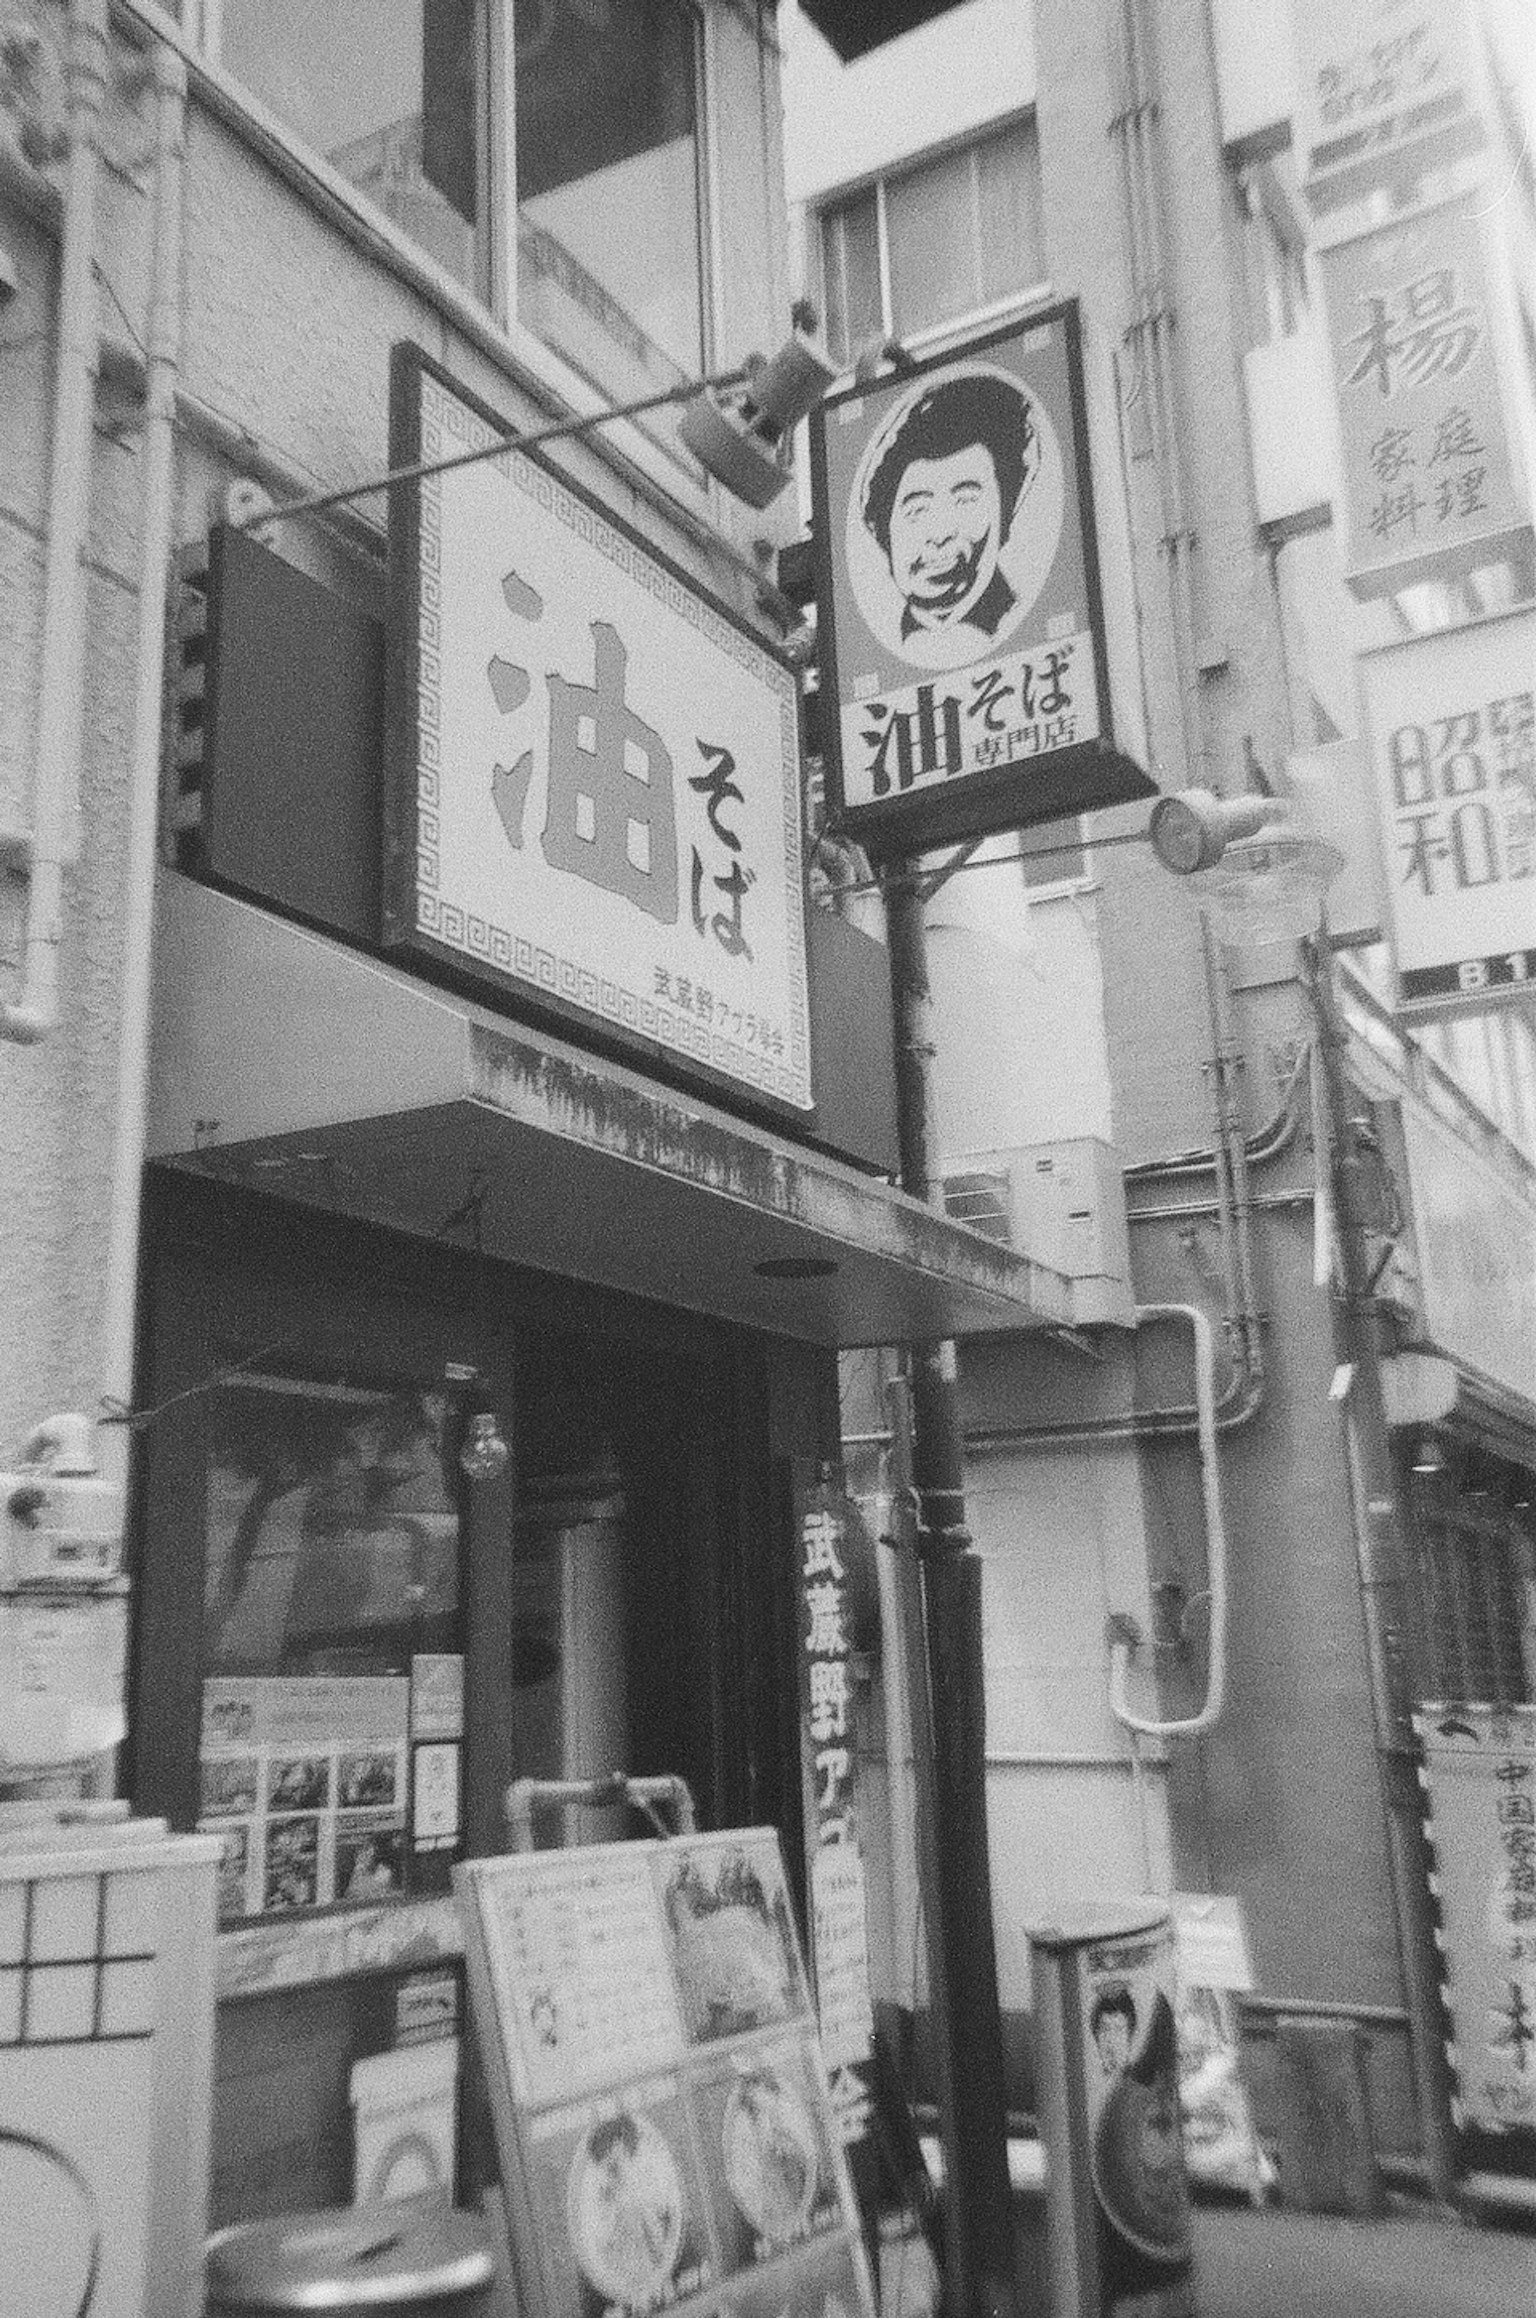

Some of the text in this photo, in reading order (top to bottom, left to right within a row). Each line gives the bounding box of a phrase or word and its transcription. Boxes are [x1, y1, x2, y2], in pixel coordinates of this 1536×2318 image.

[1343, 268, 1480, 397] 楊
[1369, 405, 1486, 484] 家庭
[1367, 466, 1488, 540] 料理
[486, 568, 758, 962] 油 そば
[859, 643, 1077, 798] 油 そば
[972, 713, 1080, 767] 専門店
